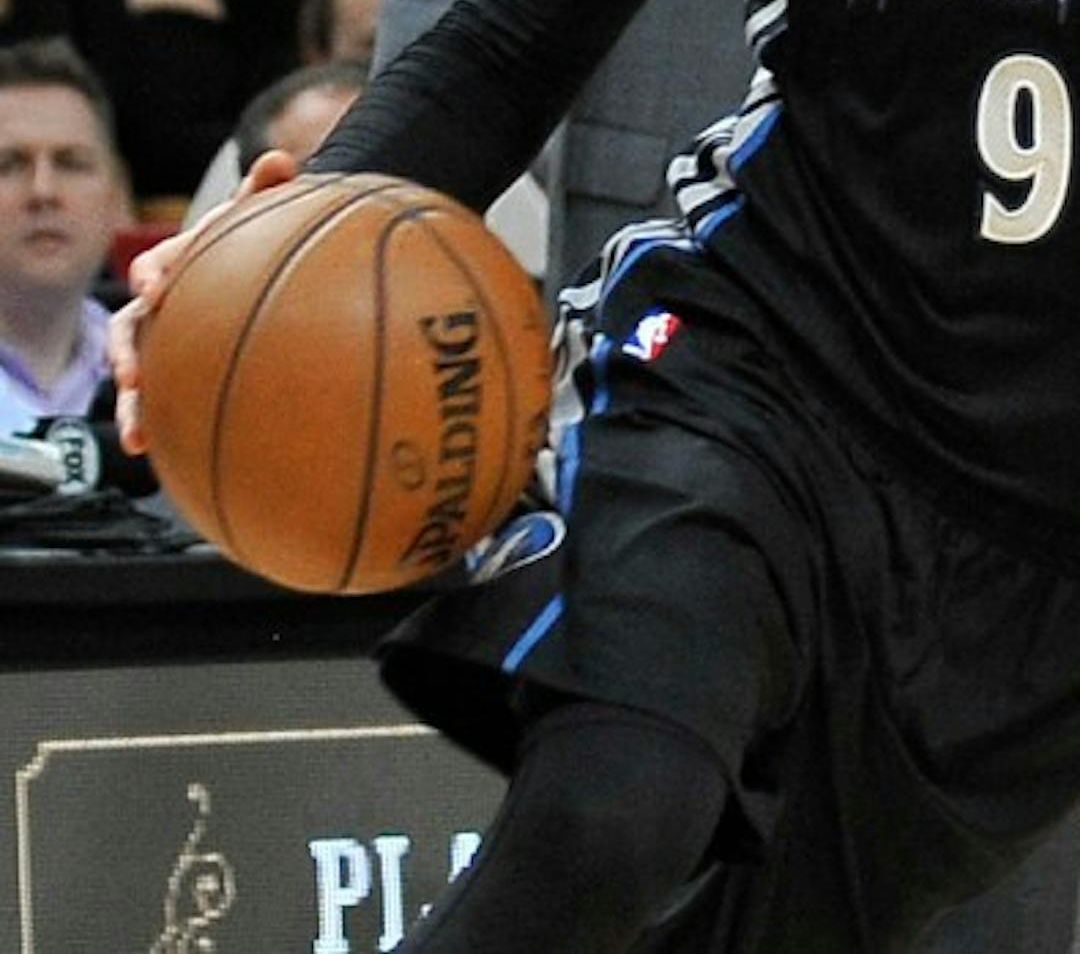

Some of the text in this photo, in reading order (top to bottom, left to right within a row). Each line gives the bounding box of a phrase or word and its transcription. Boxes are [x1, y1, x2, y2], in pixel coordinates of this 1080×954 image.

[976, 53, 1073, 244] 9
[398, 310, 482, 568] SPALDING
[308, 831, 482, 954] PL
